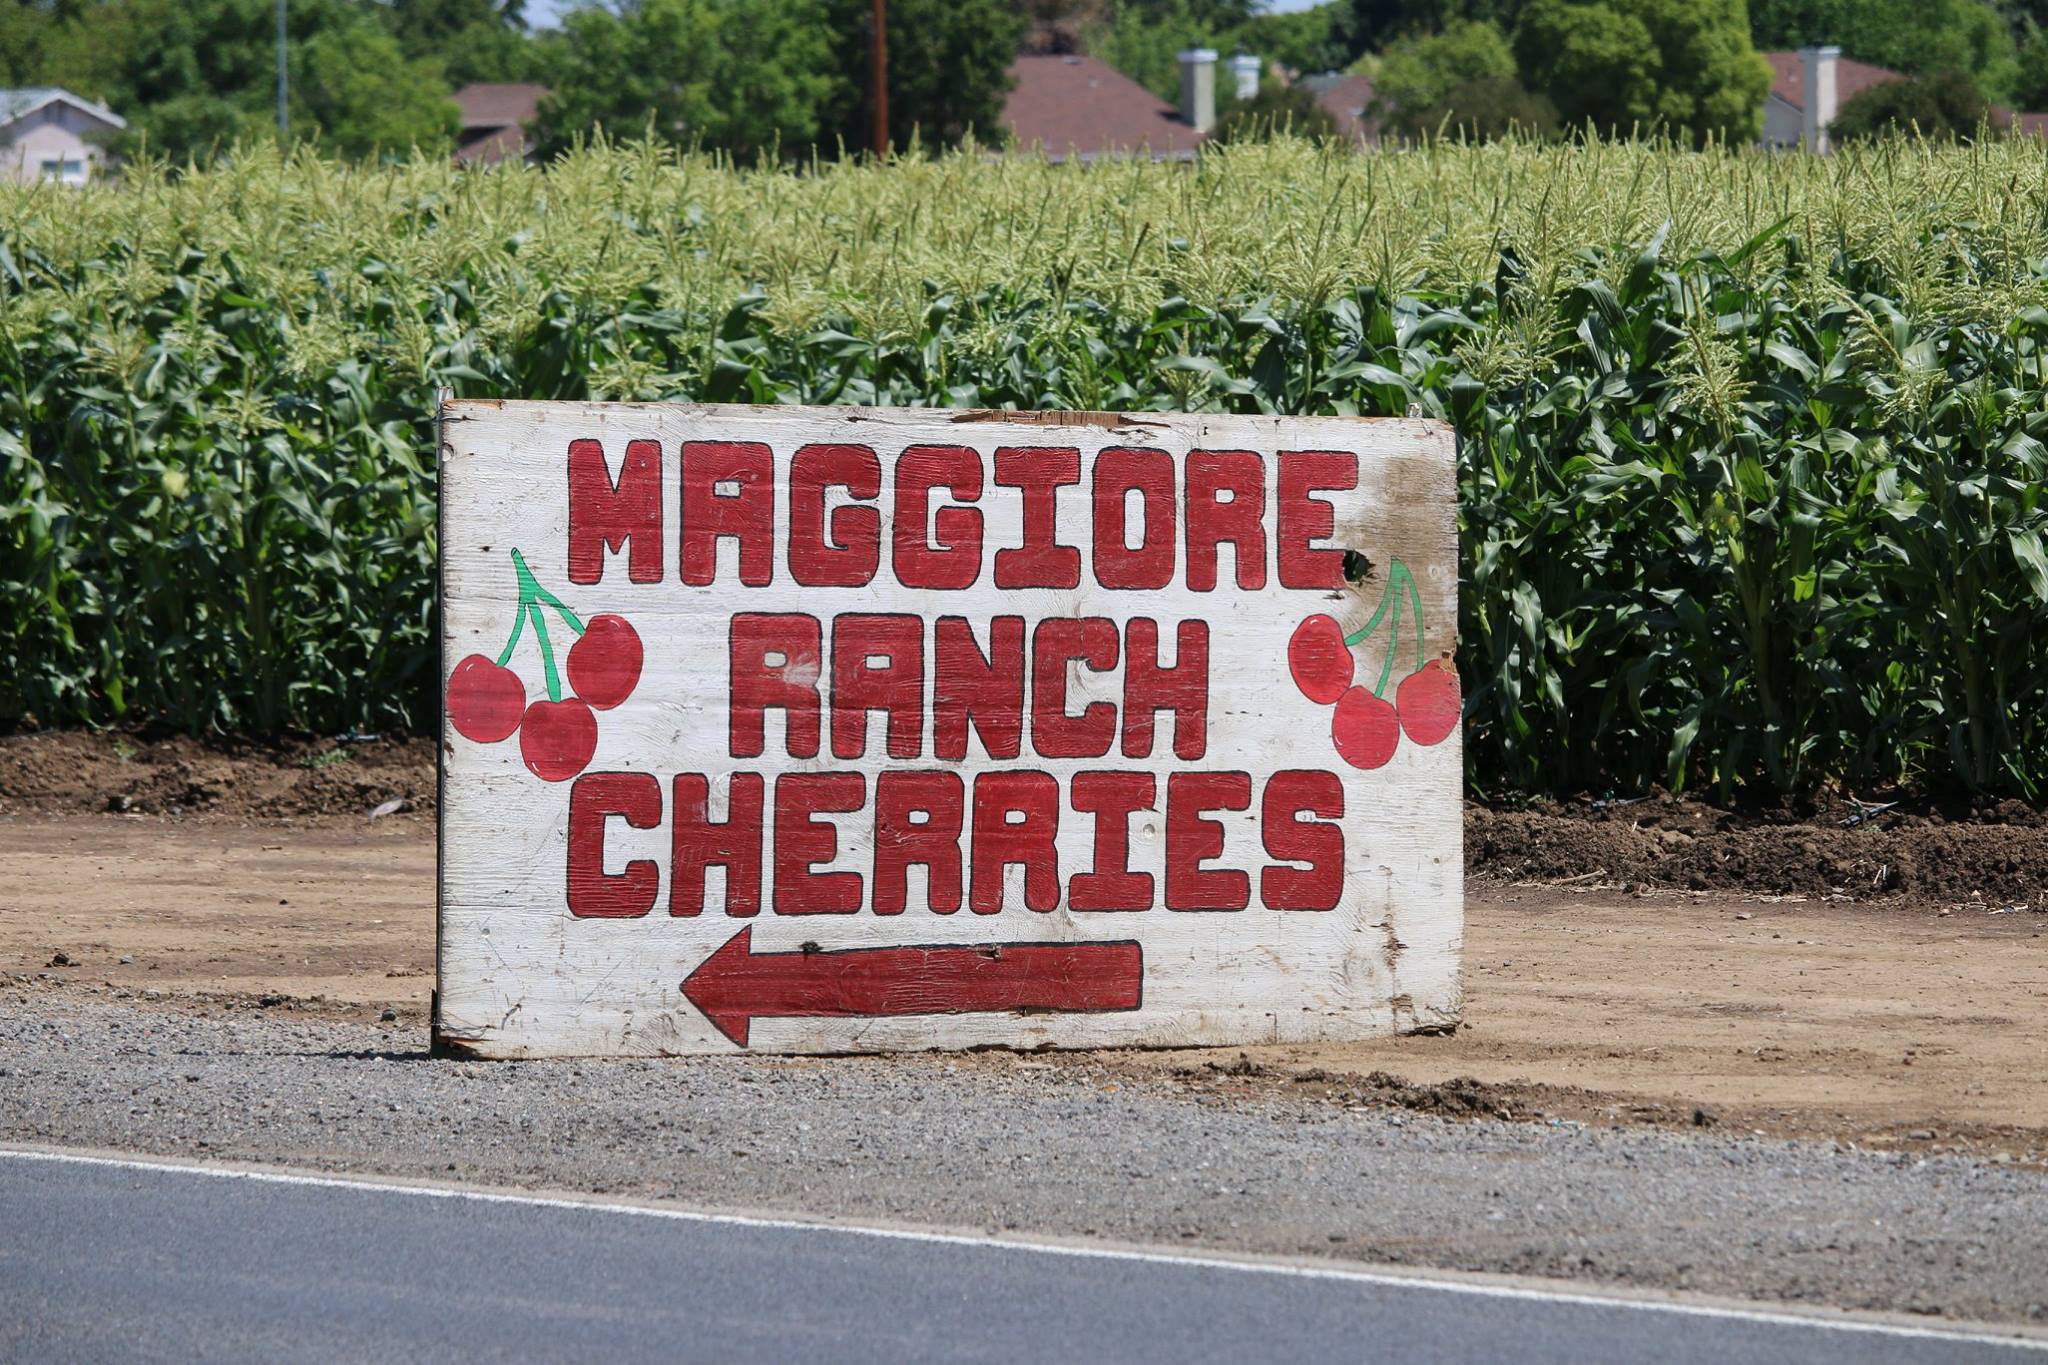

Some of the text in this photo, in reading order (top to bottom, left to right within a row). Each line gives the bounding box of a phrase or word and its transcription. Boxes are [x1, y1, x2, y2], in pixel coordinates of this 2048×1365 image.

[568, 438, 1359, 591] MAGGIORE
[729, 612, 1209, 760] RANCH
[567, 769, 1346, 918] CHERRIES
